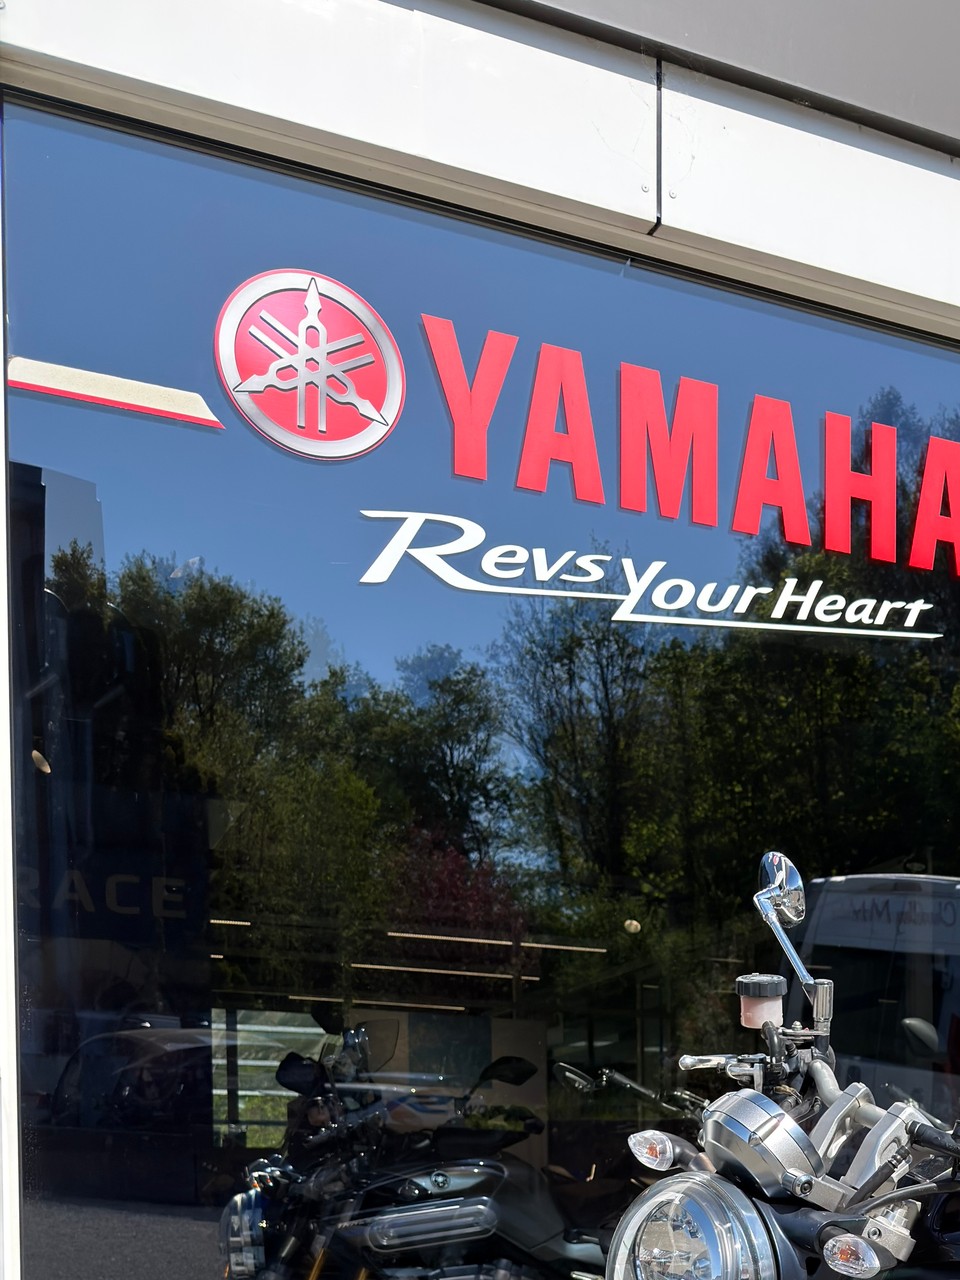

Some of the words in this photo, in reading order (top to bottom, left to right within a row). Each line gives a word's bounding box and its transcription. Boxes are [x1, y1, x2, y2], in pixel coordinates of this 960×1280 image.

[359, 510, 627, 599] Revs
[612, 557, 773, 622] Your
[770, 577, 935, 629] Heart
